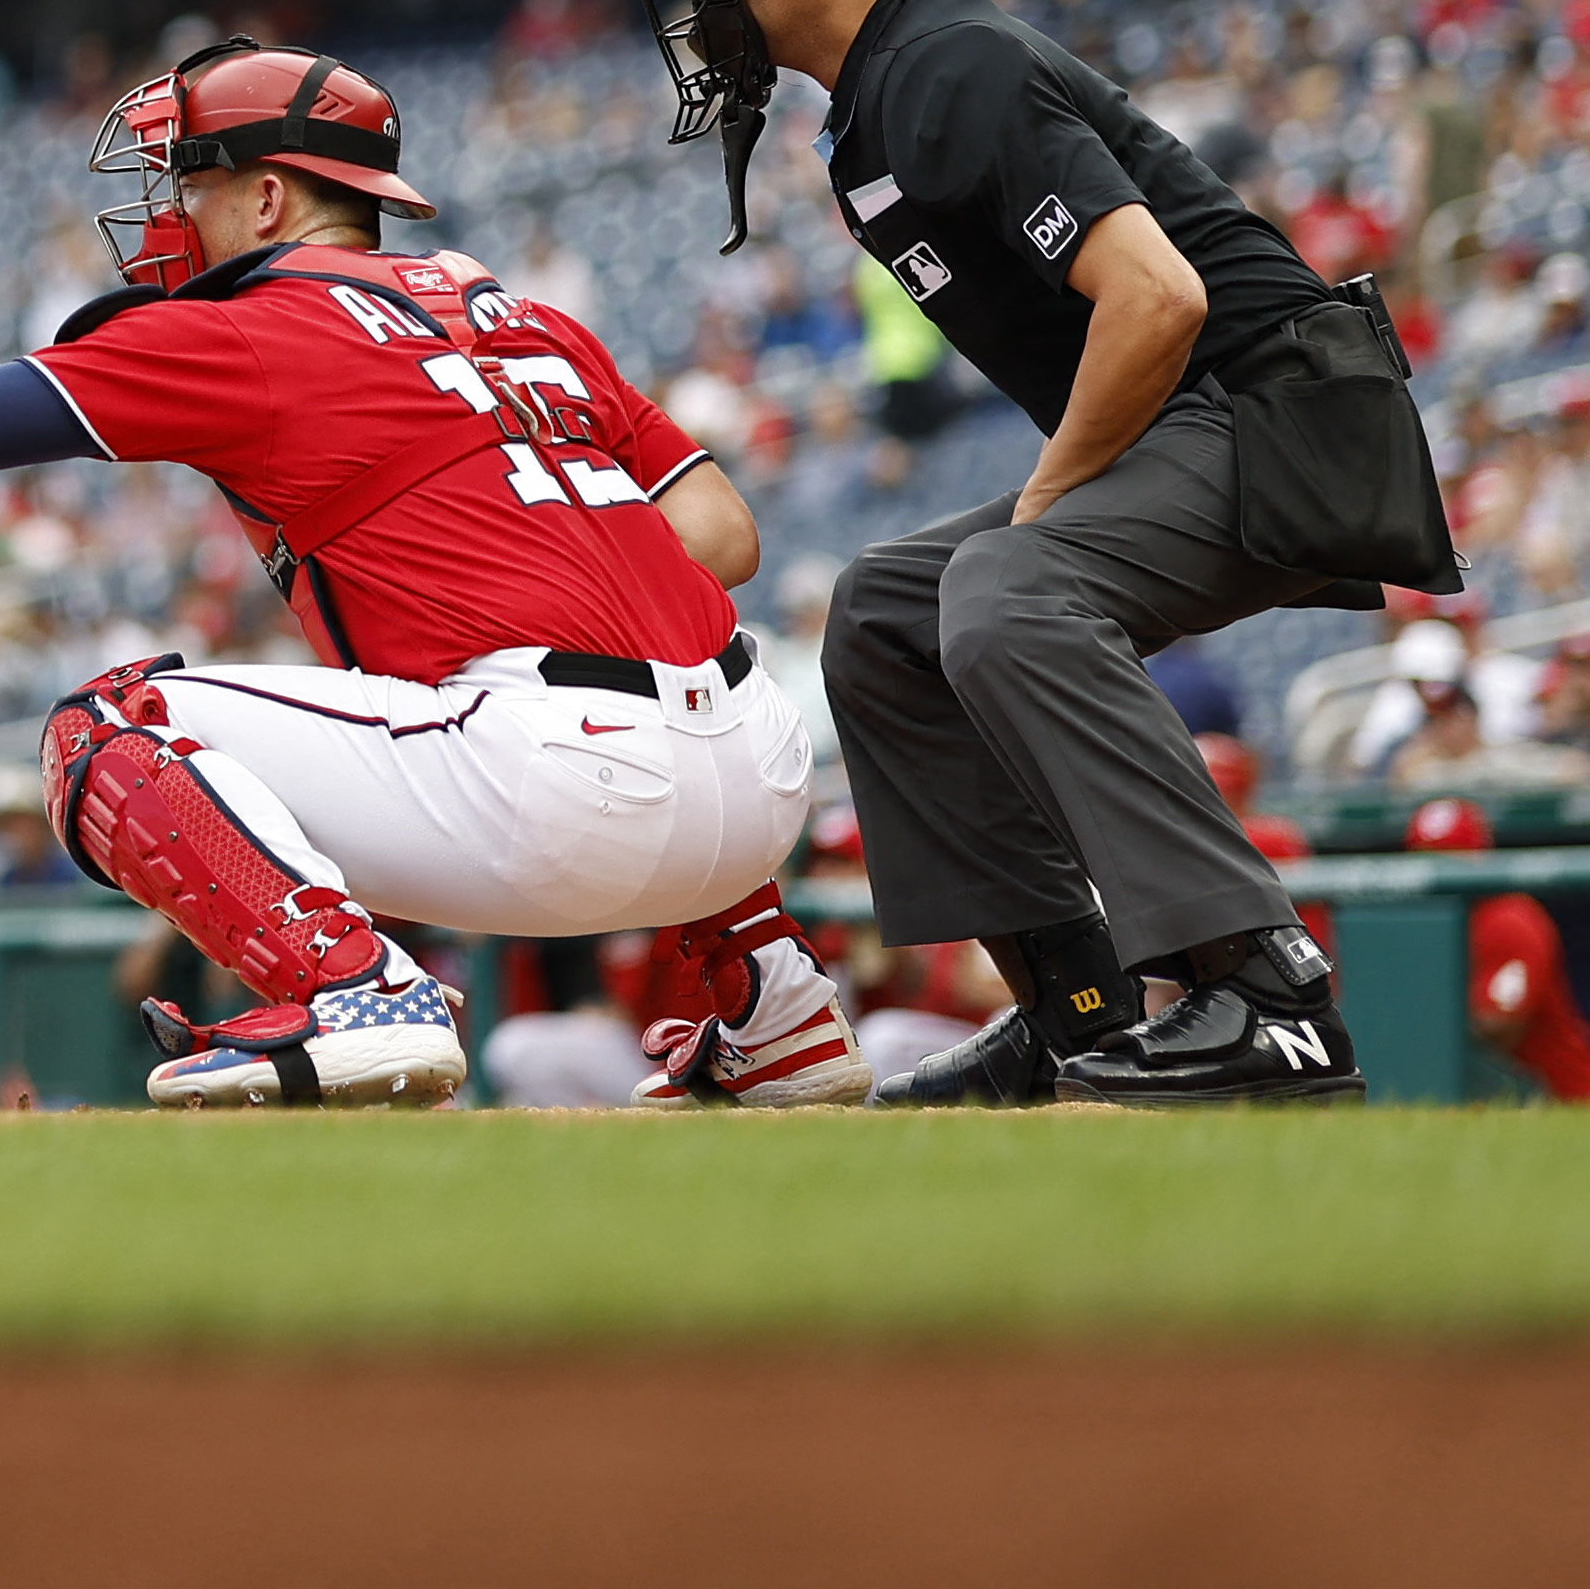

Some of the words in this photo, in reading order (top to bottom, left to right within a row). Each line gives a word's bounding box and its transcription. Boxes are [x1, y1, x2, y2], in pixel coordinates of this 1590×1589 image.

[1032, 205, 1070, 249] DM
[419, 351, 653, 508] 15
[1266, 1019, 1332, 1071] N
